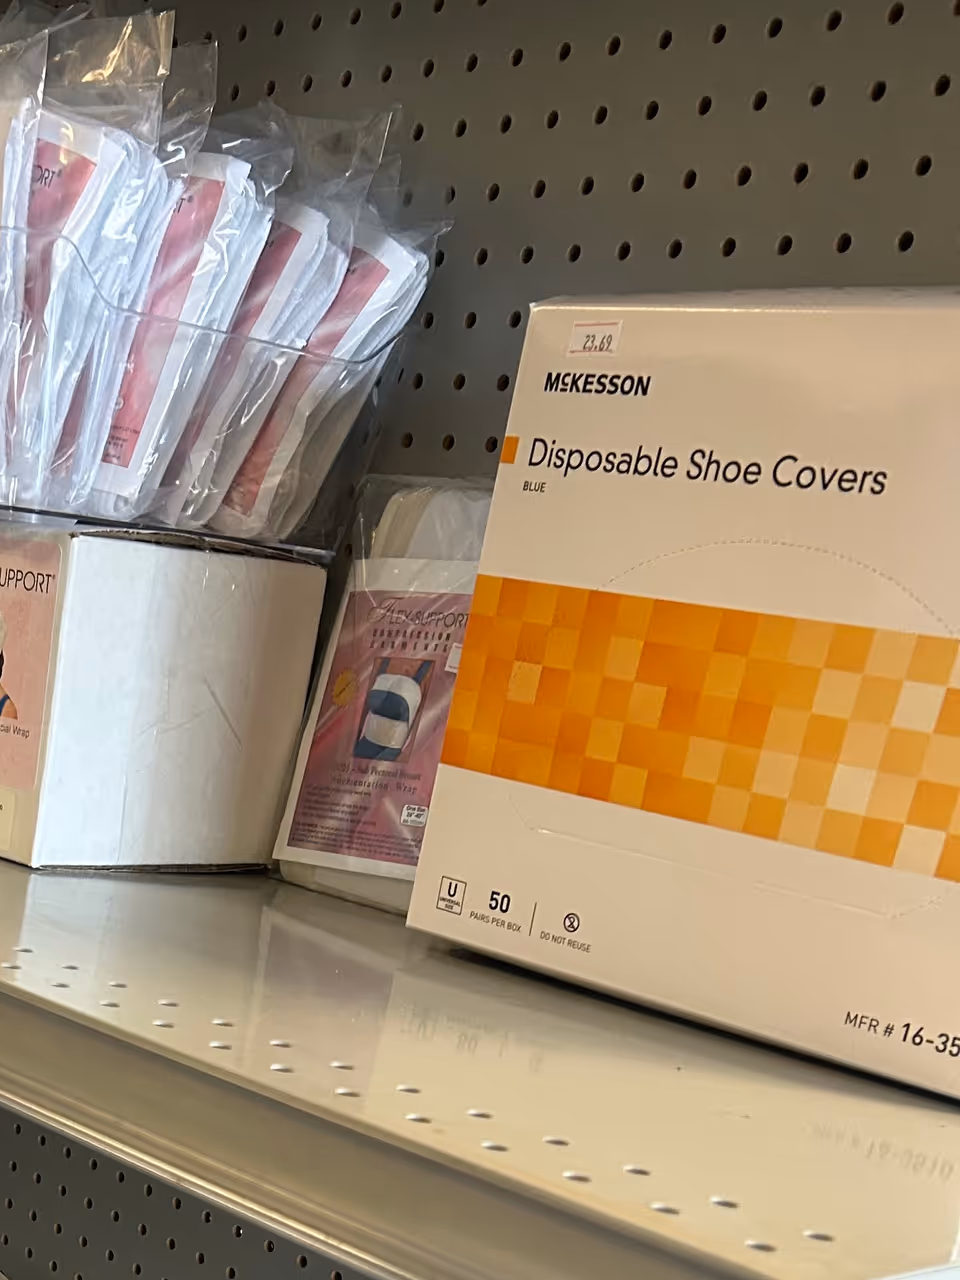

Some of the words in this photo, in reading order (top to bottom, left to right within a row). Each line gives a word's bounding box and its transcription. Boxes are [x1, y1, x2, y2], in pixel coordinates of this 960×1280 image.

[582, 334, 614, 352] 23.69
[528, 438, 679, 478] Disposable
[686, 448, 762, 485] Shoe
[772, 455, 888, 495] Covers
[523, 480, 547, 493] BLUE
[12, 724, 30, 739] Wrap
[447, 882, 458, 898] U
[489, 891, 511, 913] 50
[469, 911, 490, 924] PAIRS
[490, 917, 506, 929] PER
[507, 921, 522, 933] BOX
[540, 931, 550, 941] DO
[552, 934, 566, 946] NOT
[567, 939, 592, 953] REUSE
[844, 1011, 880, 1033] MFR
[883, 1023, 895, 1037] #
